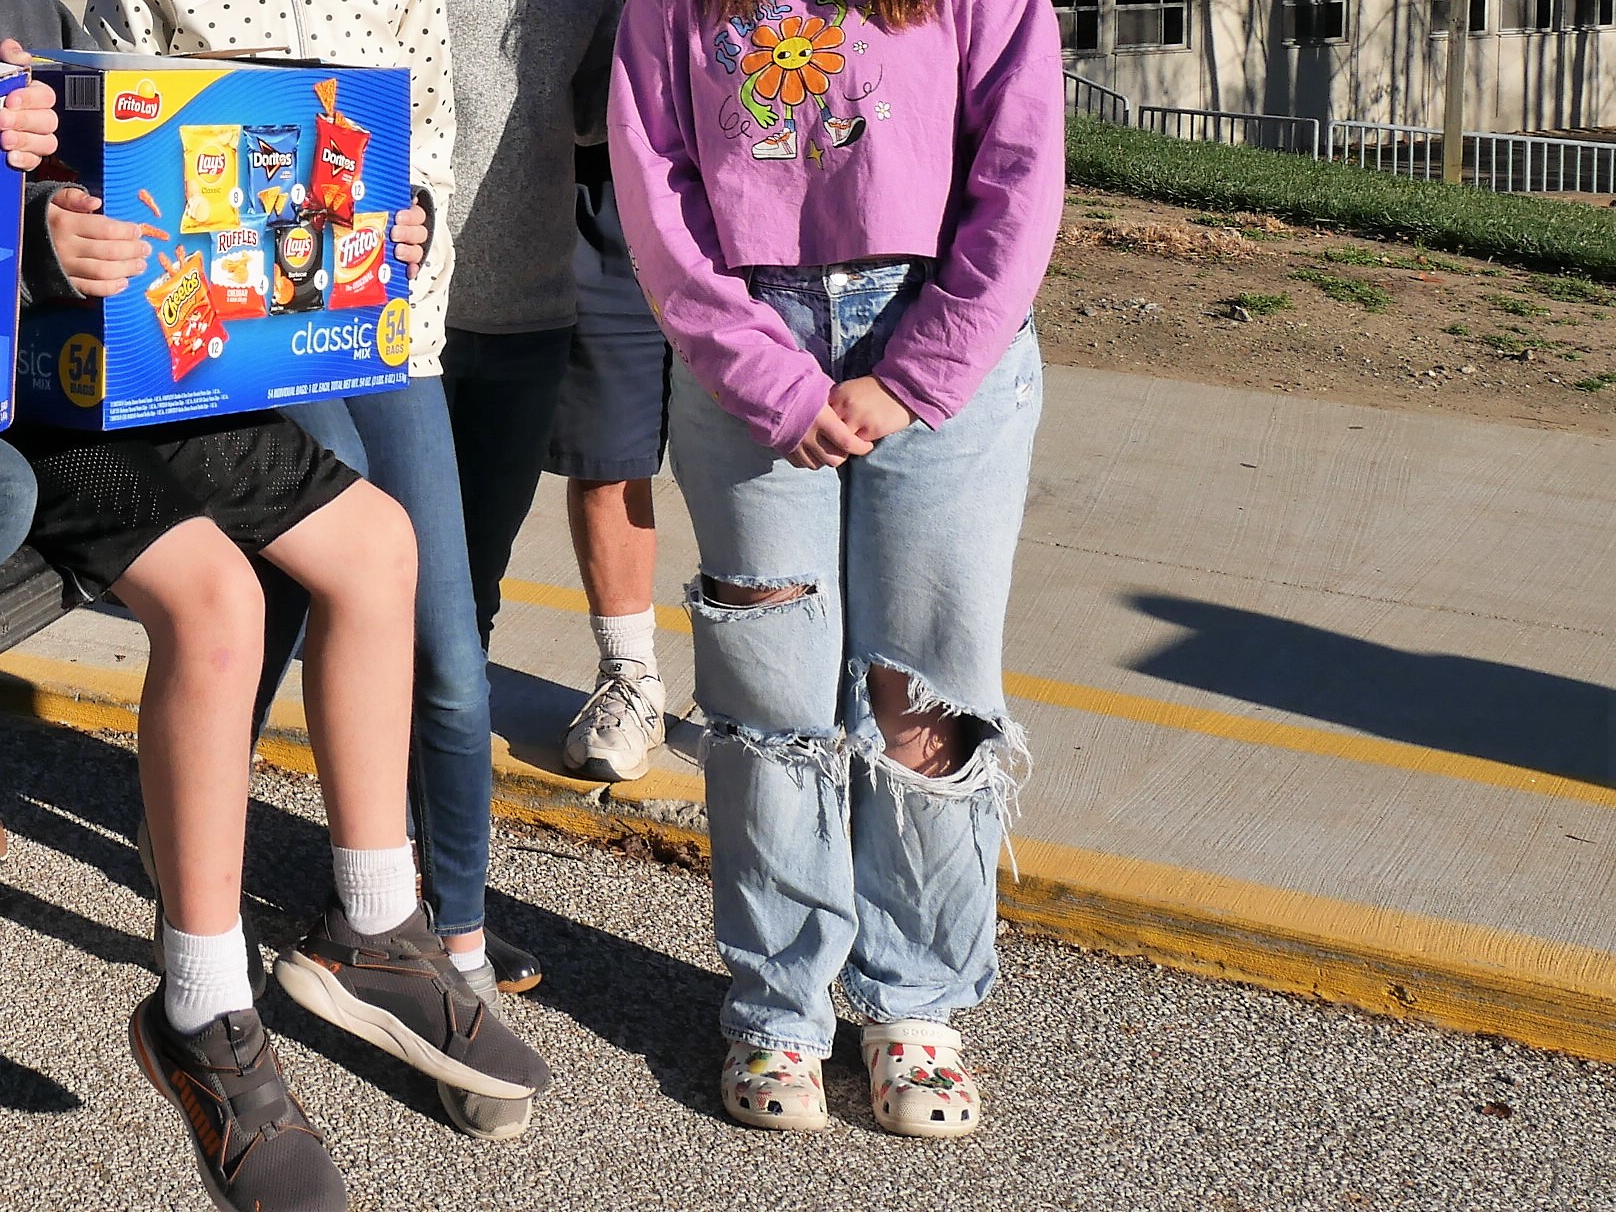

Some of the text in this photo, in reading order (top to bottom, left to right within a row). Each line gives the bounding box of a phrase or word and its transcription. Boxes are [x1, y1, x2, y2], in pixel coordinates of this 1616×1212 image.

[714, 31, 741, 74] IT
[198, 153, 226, 176] Lay's
[253, 150, 292, 168] Doritos
[322, 148, 356, 172] Doritos
[233, 191, 239, 204] 8
[295, 188, 301, 200] 7
[353, 184, 362, 197] 12
[218, 230, 258, 253] RUFFLES
[338, 226, 379, 268] Fritos
[318, 274, 324, 285] 4
[382, 268, 387, 280] 7
[259, 279, 264, 292] 4
[162, 271, 199, 326] Cheetos
[385, 309, 406, 344] 54
[291, 317, 373, 356] classic
[210, 342, 220, 354] 12
[353, 348, 371, 360] MIX
[385, 344, 404, 356] BAGS
[69, 344, 98, 383] 54
[32, 379, 51, 391] MIX
